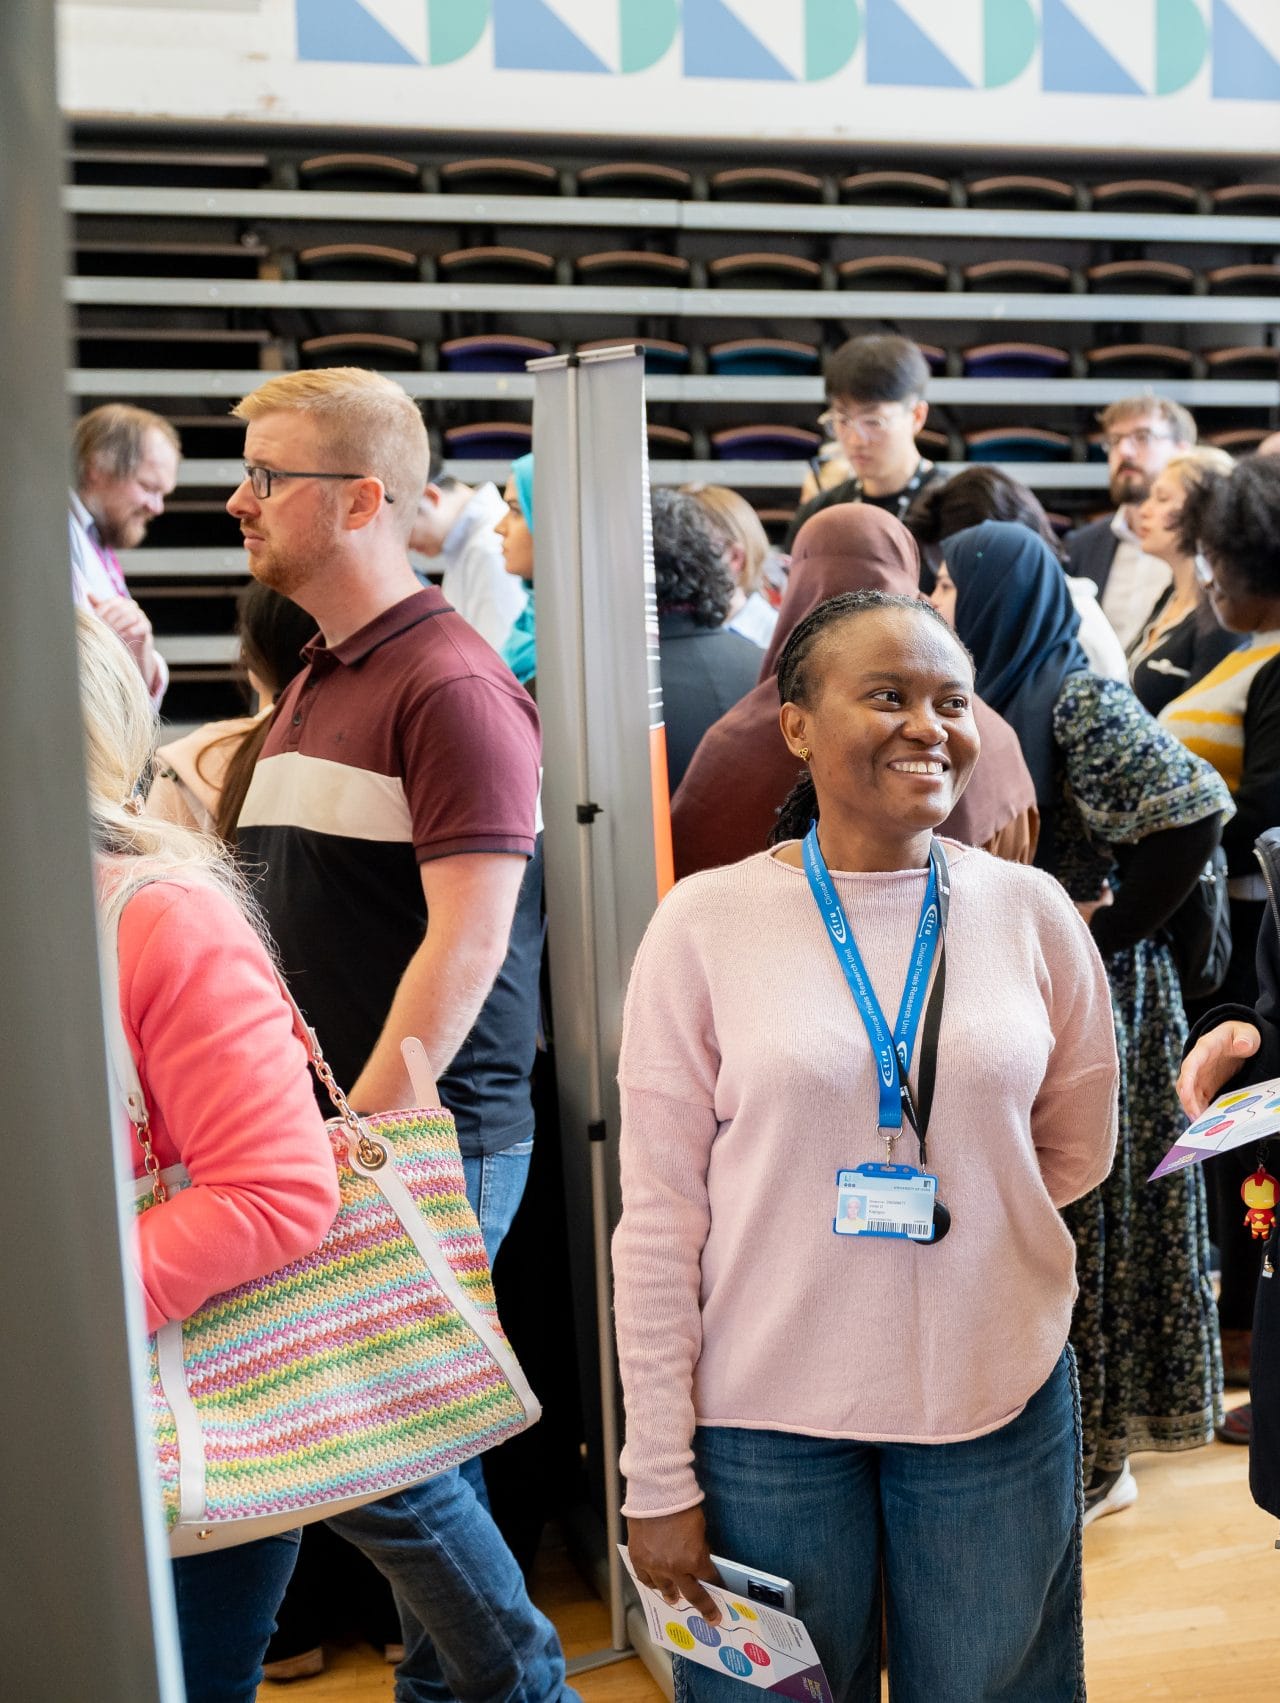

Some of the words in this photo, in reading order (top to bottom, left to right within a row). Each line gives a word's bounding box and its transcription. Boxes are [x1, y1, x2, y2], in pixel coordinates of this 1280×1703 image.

[829, 911, 843, 935] ctru
[924, 912, 936, 936] ctru
[900, 1018, 910, 1035] Unit
[880, 1050, 891, 1077] ctru
